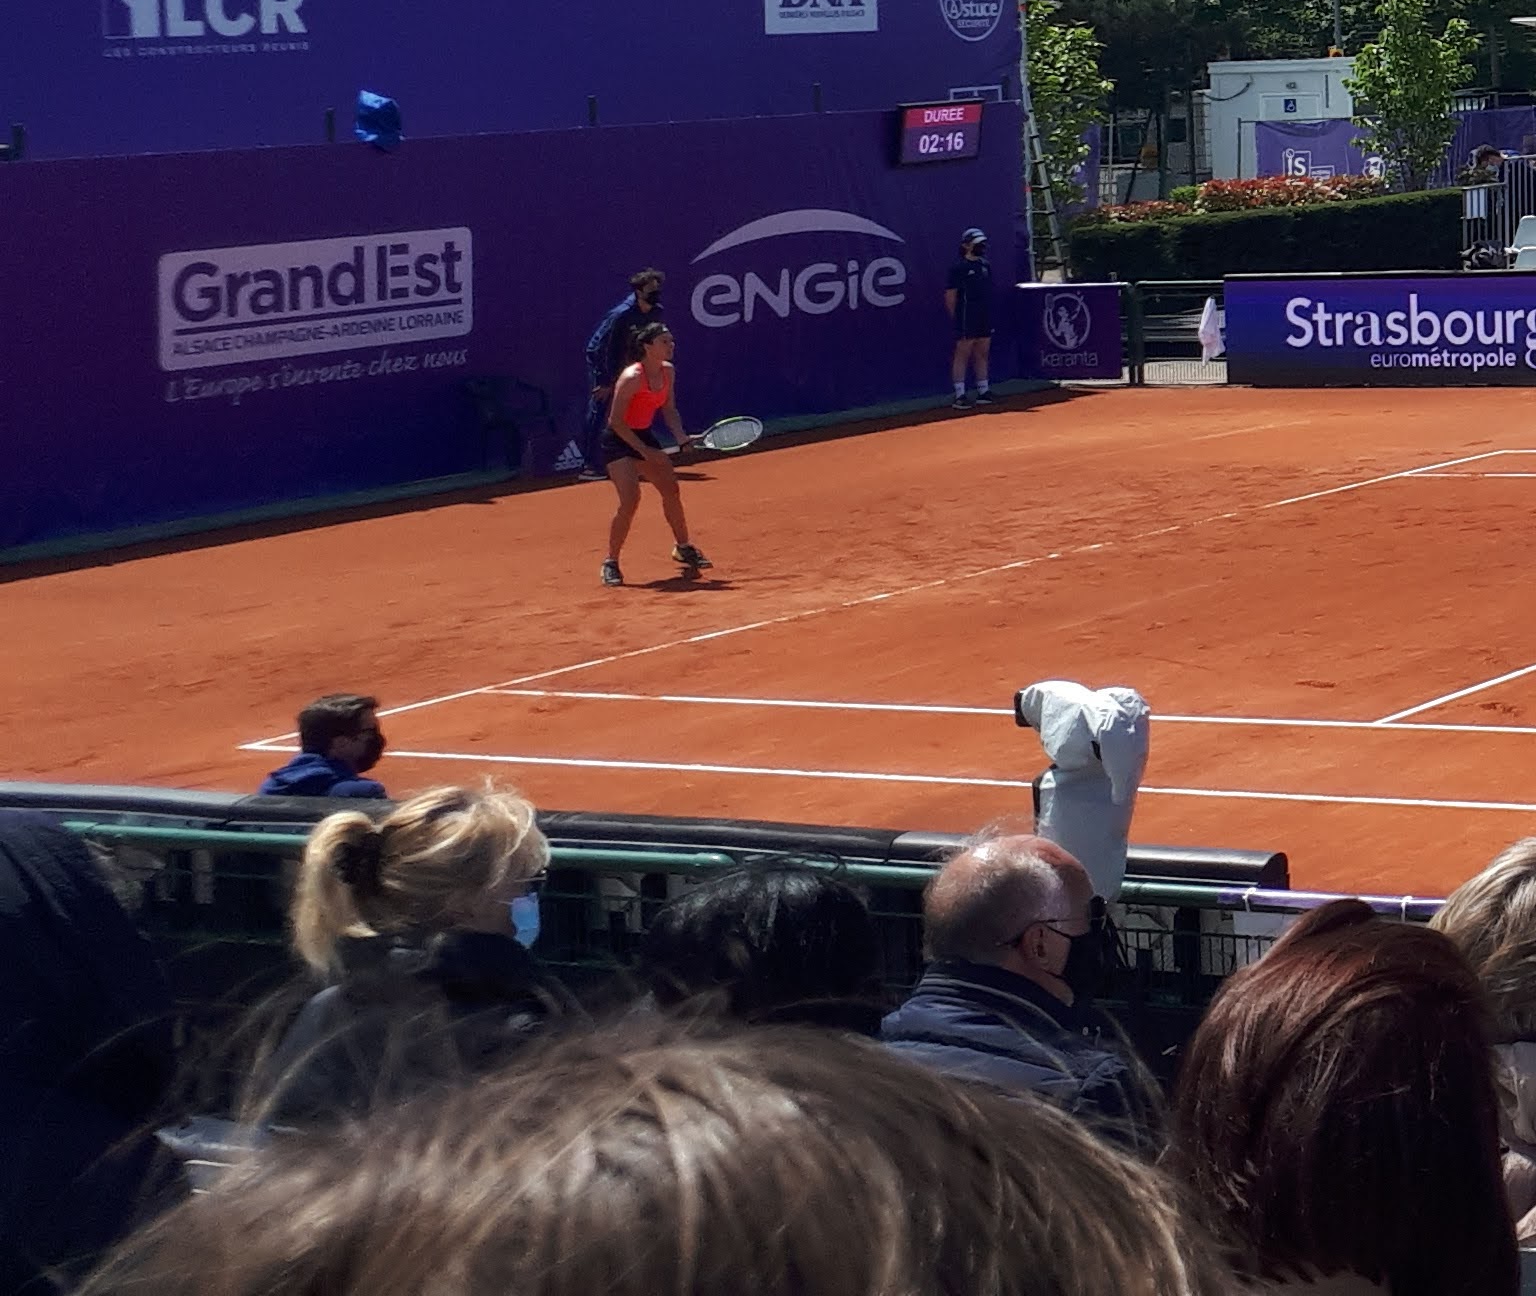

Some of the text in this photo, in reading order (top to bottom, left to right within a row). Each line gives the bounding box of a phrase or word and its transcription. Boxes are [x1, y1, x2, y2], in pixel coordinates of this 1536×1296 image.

[924, 107, 965, 123] DUREE
[919, 131, 965, 154] 02:16
[173, 241, 462, 322] Grand Est
[400, 310, 465, 329] LORRAINE
[367, 351, 417, 376] chez
[1370, 347, 1517, 372] eurométropole
